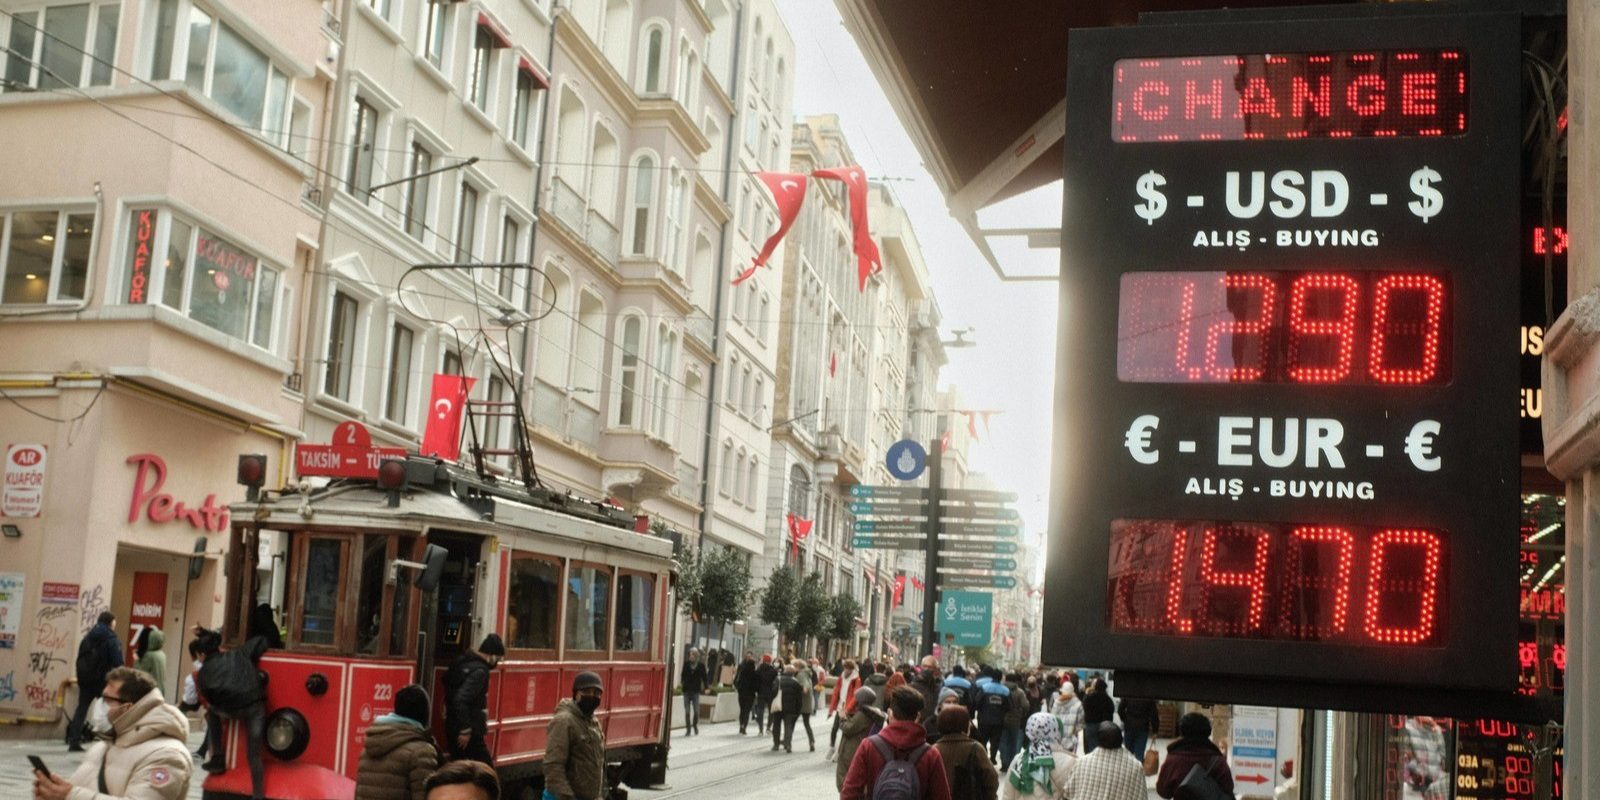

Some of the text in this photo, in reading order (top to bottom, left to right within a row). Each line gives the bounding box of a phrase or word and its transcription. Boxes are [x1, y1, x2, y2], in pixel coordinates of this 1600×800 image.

[1132, 72, 1437, 120] CHANGE
[1134, 170, 1168, 225] $
[1225, 170, 1350, 218] USD
[1408, 165, 1444, 223] $
[1193, 230, 1251, 251] ALIŞ
[1276, 229, 1379, 247] BUYING
[347, 424, 356, 444] 2
[1124, 415, 1160, 465] €
[1217, 416, 1346, 469] EUR
[1404, 419, 1442, 472] €
[18, 451, 37, 464] AR
[301, 449, 340, 469] TAKSİM
[6, 469, 43, 485] KUAFÖR
[126, 453, 229, 532] Penti
[1185, 477, 1243, 500] ALIŞ
[1269, 480, 1375, 499] BUYING
[374, 683, 392, 700] 223
